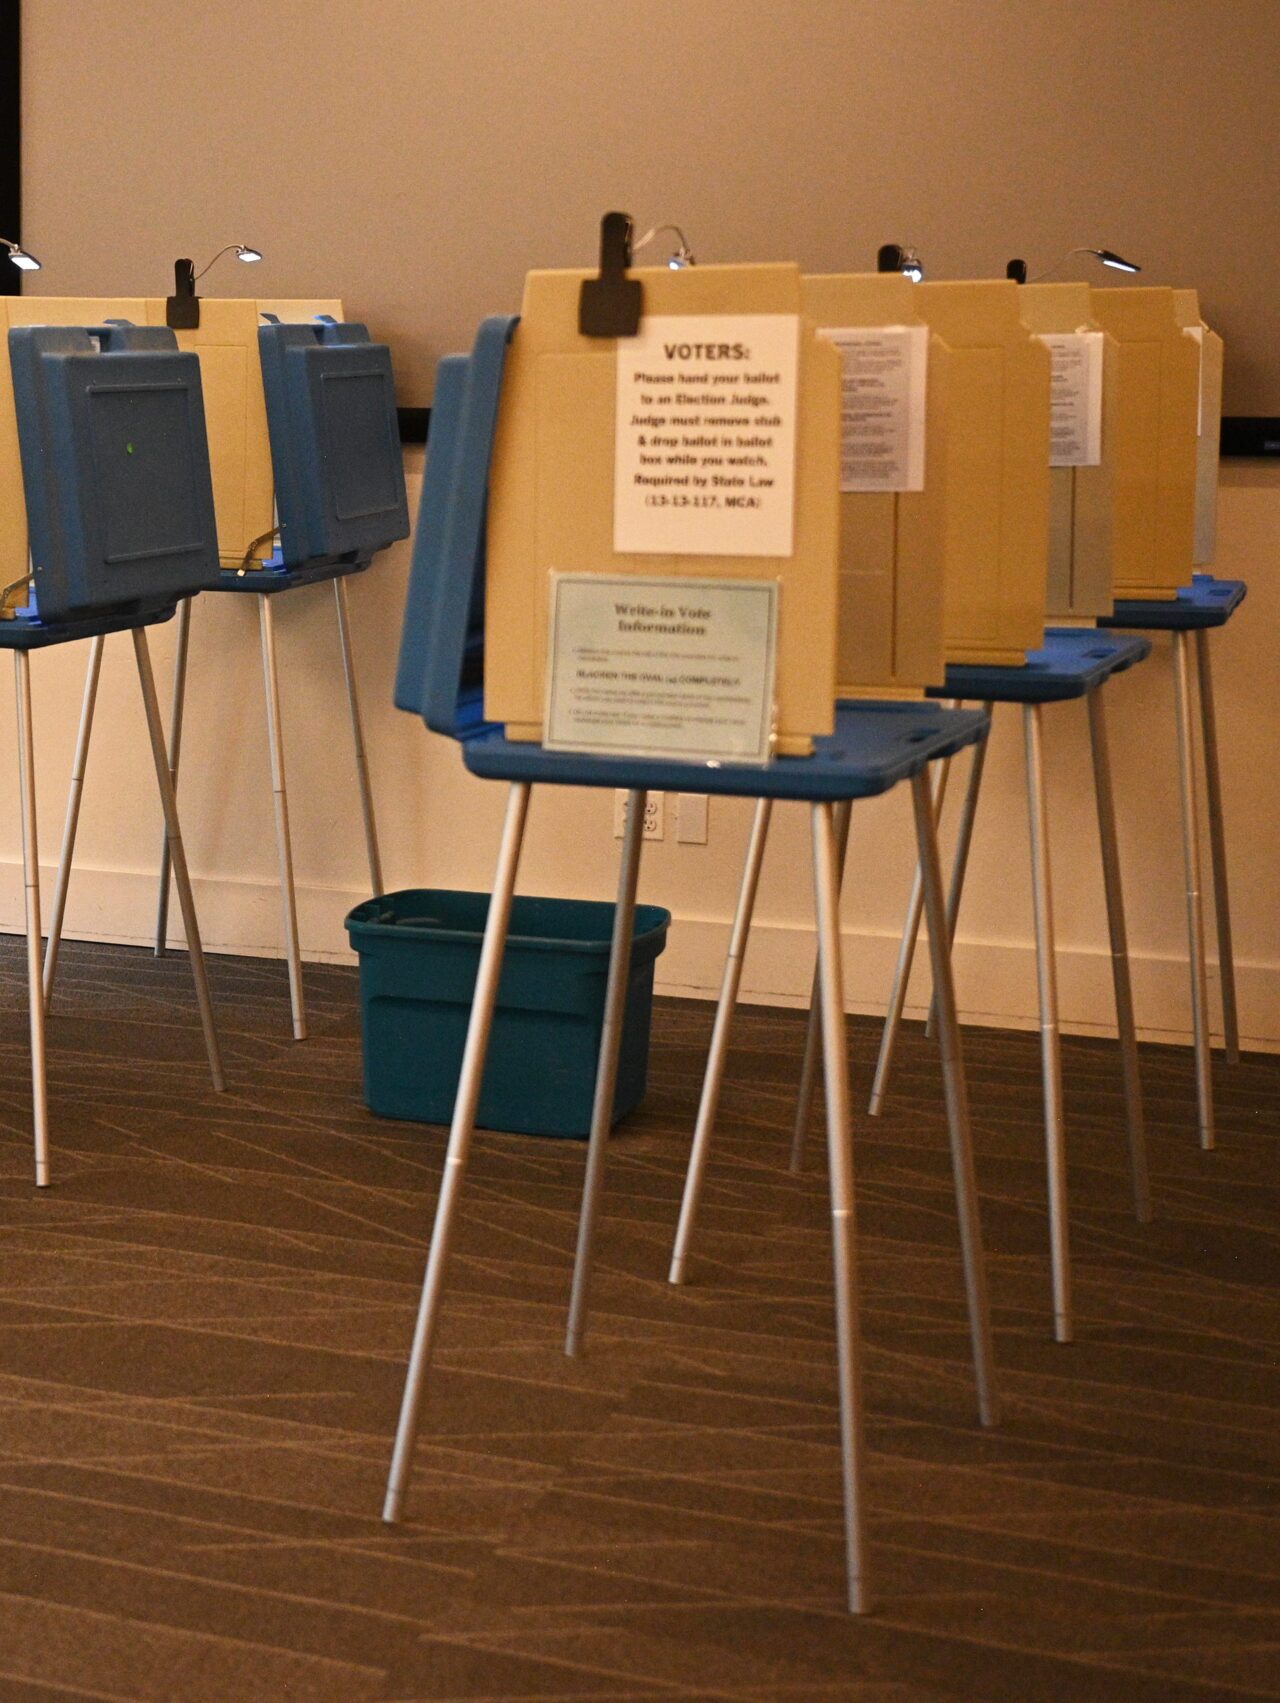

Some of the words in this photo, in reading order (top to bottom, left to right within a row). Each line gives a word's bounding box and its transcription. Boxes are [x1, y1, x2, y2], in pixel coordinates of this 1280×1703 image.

[664, 344, 750, 360] VOTERS:
[634, 373, 673, 383] Please
[678, 373, 708, 383] hand
[711, 373, 739, 386] your
[743, 373, 780, 383] ballot
[641, 394, 652, 405] to
[657, 395, 671, 405] an
[675, 394, 726, 405] Election
[631, 416, 665, 428] Judge
[670, 416, 700, 426] must
[704, 416, 750, 426] remove
[754, 416, 781, 427] stub
[638, 436, 646, 446] &
[650, 436, 678, 449] drop
[682, 436, 717, 446] ballot
[722, 436, 732, 446] in
[736, 436, 773, 447] ballot
[640, 455, 662, 465] box
[666, 455, 697, 465] while
[702, 455, 722, 468] you
[634, 475, 688, 487] Required
[693, 475, 707, 487] by
[711, 475, 744, 486] State
[749, 476, 773, 486] Law
[615, 603, 675, 617] Write-in
[679, 604, 711, 620] Vote
[619, 620, 706, 636] Information
